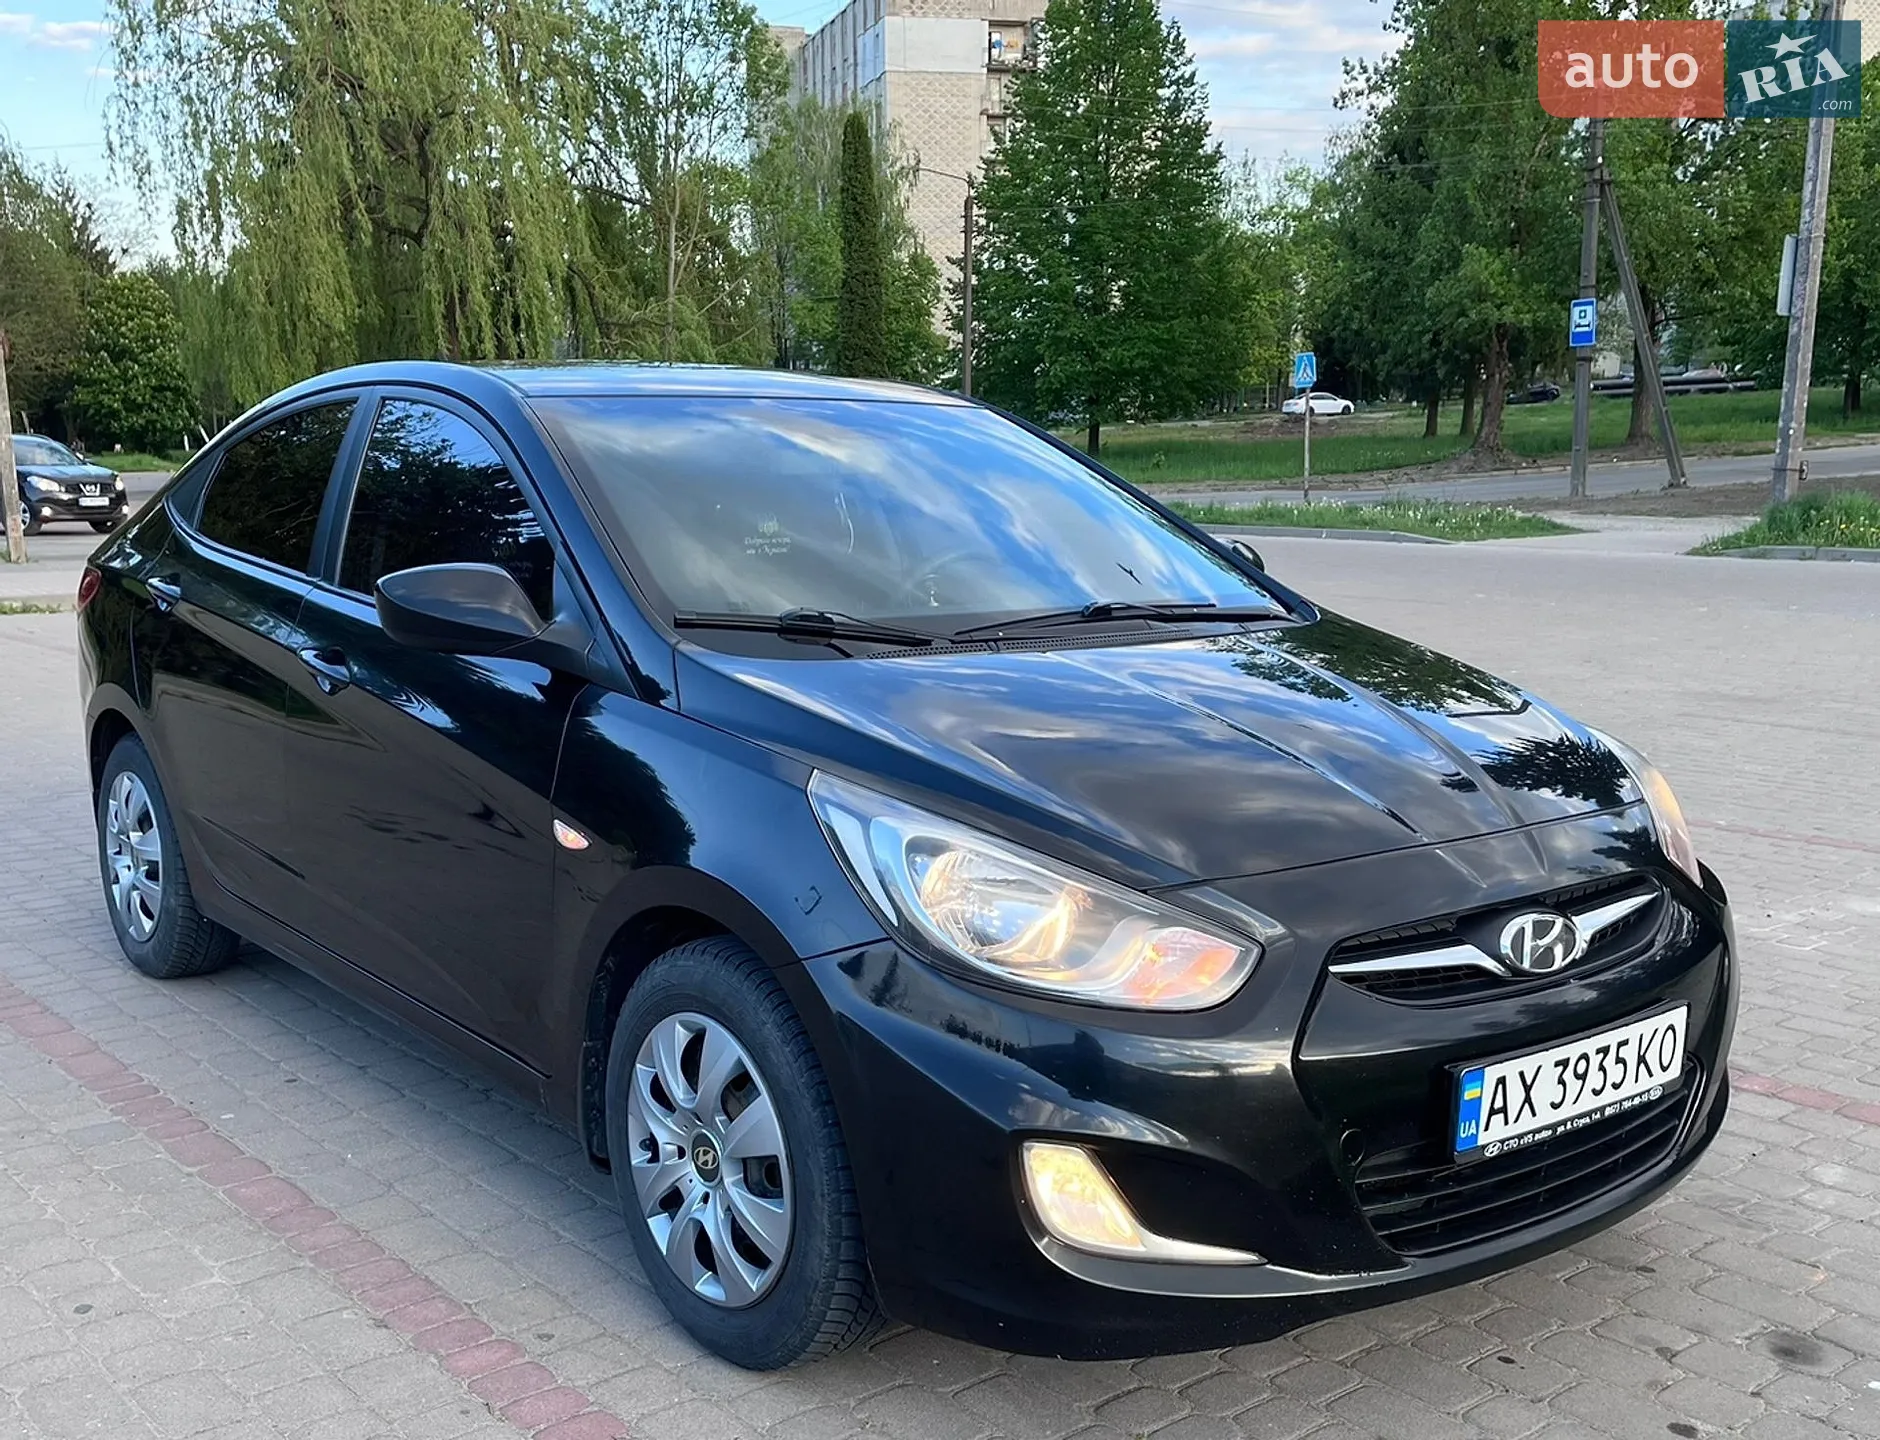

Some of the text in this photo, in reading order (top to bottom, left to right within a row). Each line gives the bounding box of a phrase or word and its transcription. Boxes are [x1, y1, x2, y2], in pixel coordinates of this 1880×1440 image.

[1483, 1023, 1677, 1132] AX 3935 KO
[1460, 1118, 1478, 1138] UA
